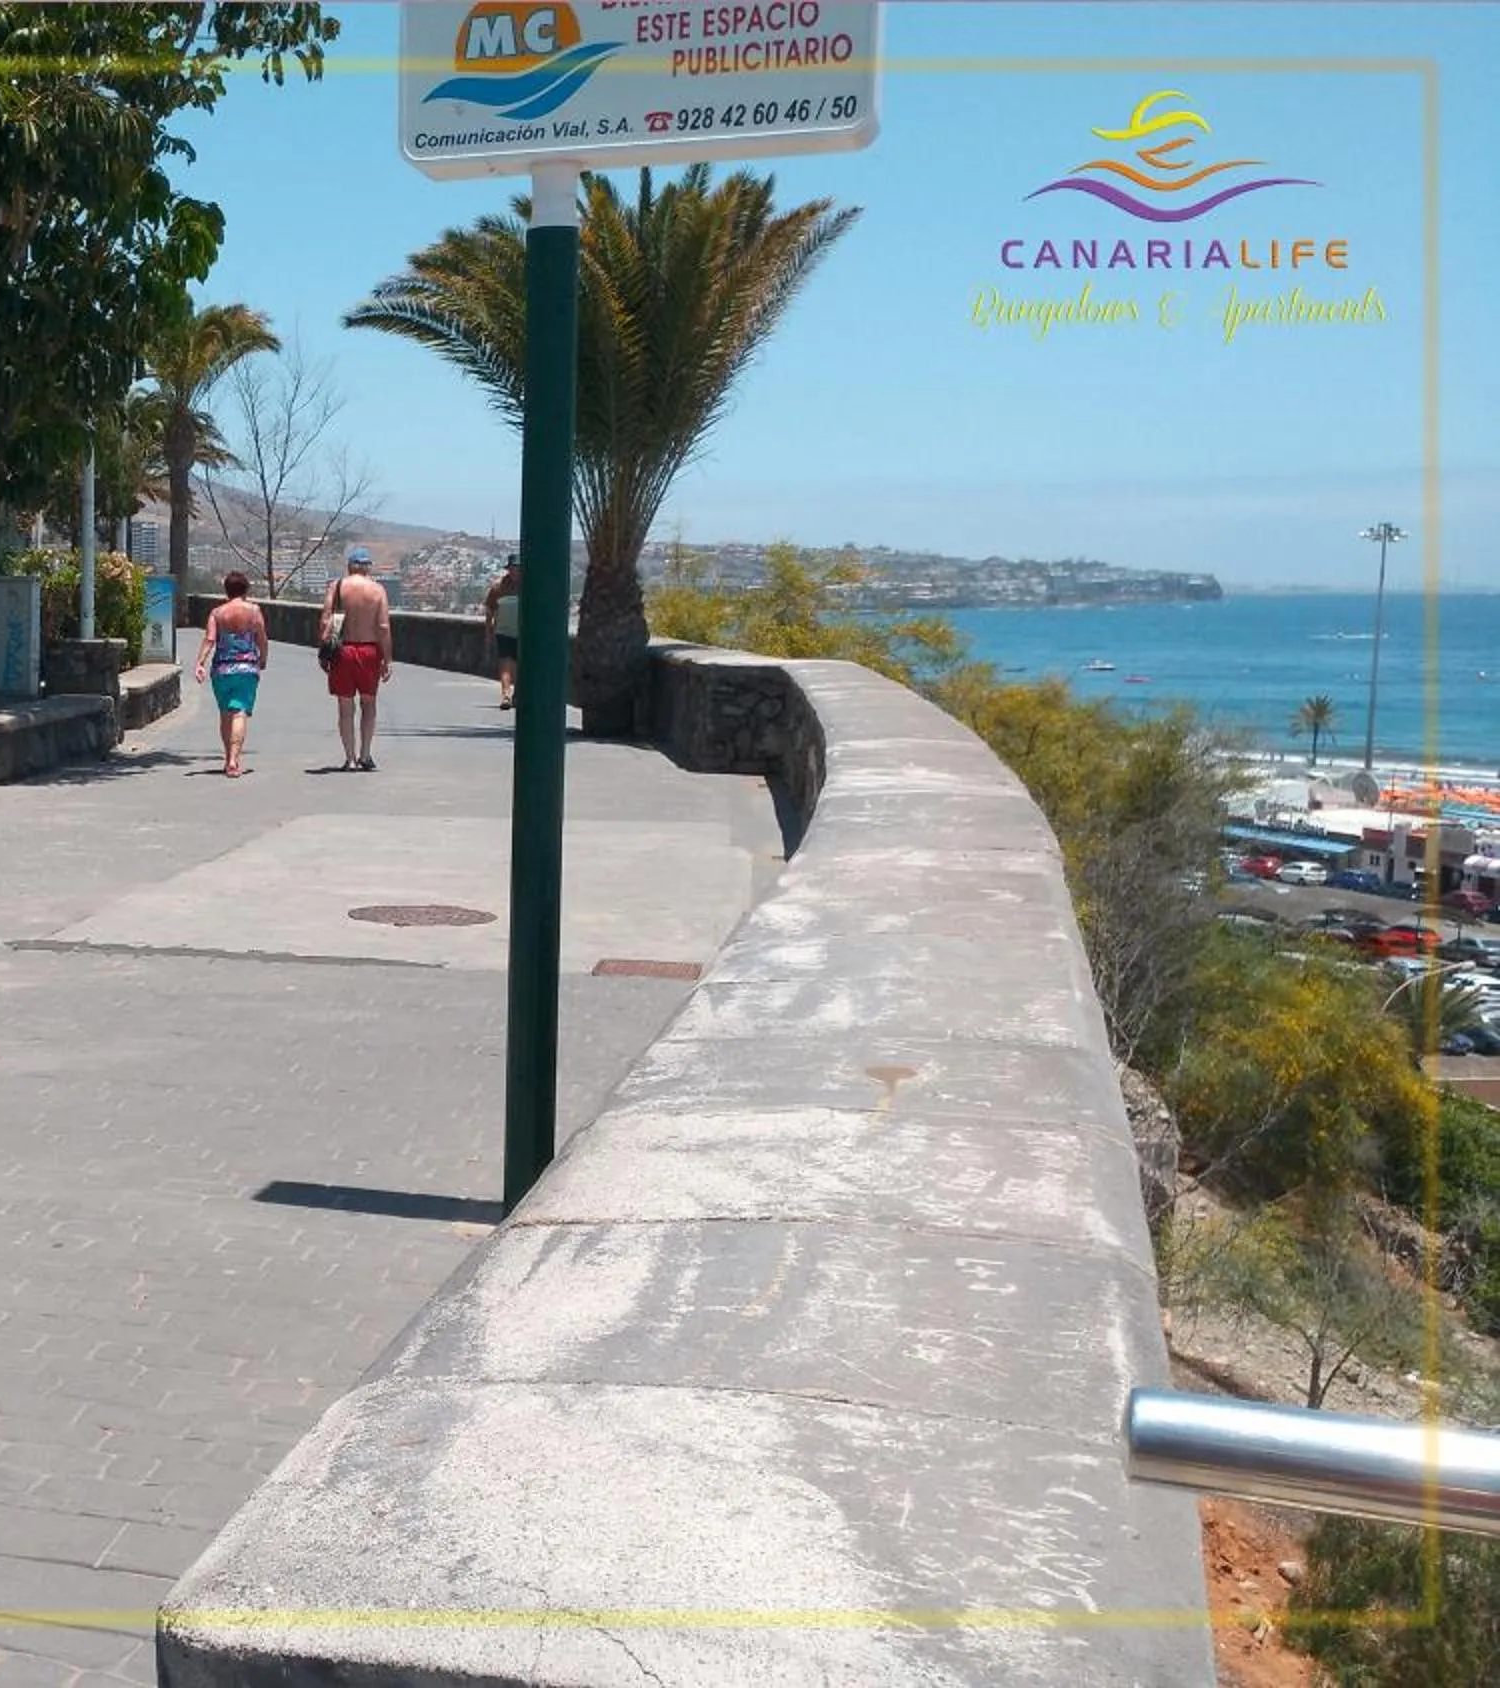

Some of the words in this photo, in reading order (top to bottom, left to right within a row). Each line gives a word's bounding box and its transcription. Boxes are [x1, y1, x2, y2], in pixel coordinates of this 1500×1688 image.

[636, 11, 691, 43] ESTE
[702, 1, 821, 37] ESPACIO
[672, 33, 853, 77] PUBLICITARIO
[414, 125, 546, 149] Comunicación
[552, 120, 590, 138] Vial,
[596, 116, 635, 135] S.A.
[676, 106, 715, 131] 928
[719, 103, 747, 127] 42
[753, 101, 779, 125] 60
[784, 99, 811, 122] 46
[815, 97, 827, 120] /
[831, 95, 857, 119] 50
